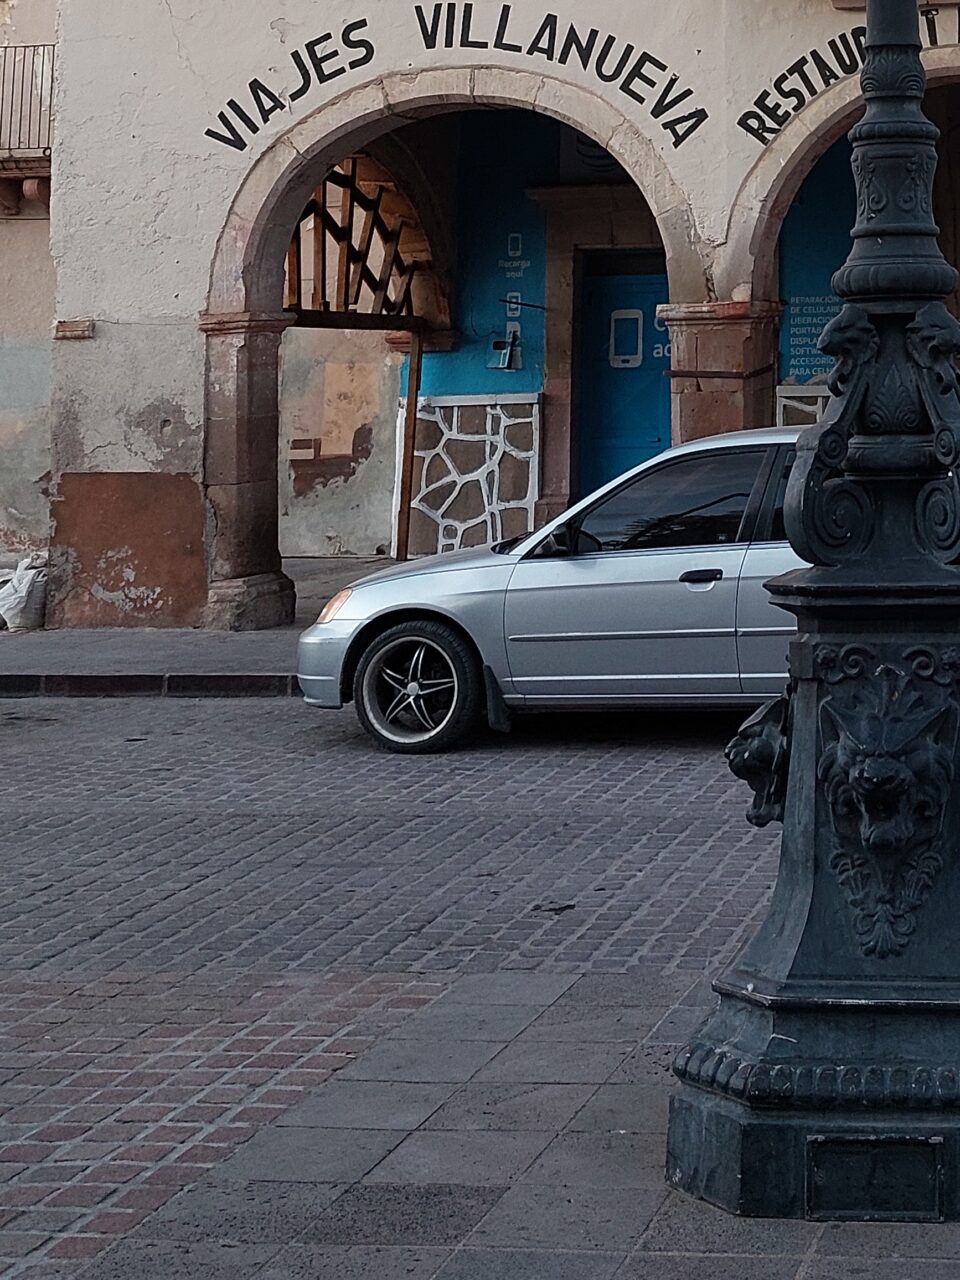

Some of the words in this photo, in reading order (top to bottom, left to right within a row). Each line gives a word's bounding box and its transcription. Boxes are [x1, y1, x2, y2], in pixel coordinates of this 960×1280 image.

[203, 17, 376, 153] VIAJES
[413, 1, 711, 150] VILLANUEVA
[497, 259, 531, 270] Recarga
[790, 305, 801, 314] DE
[789, 367, 811, 376] PARA
